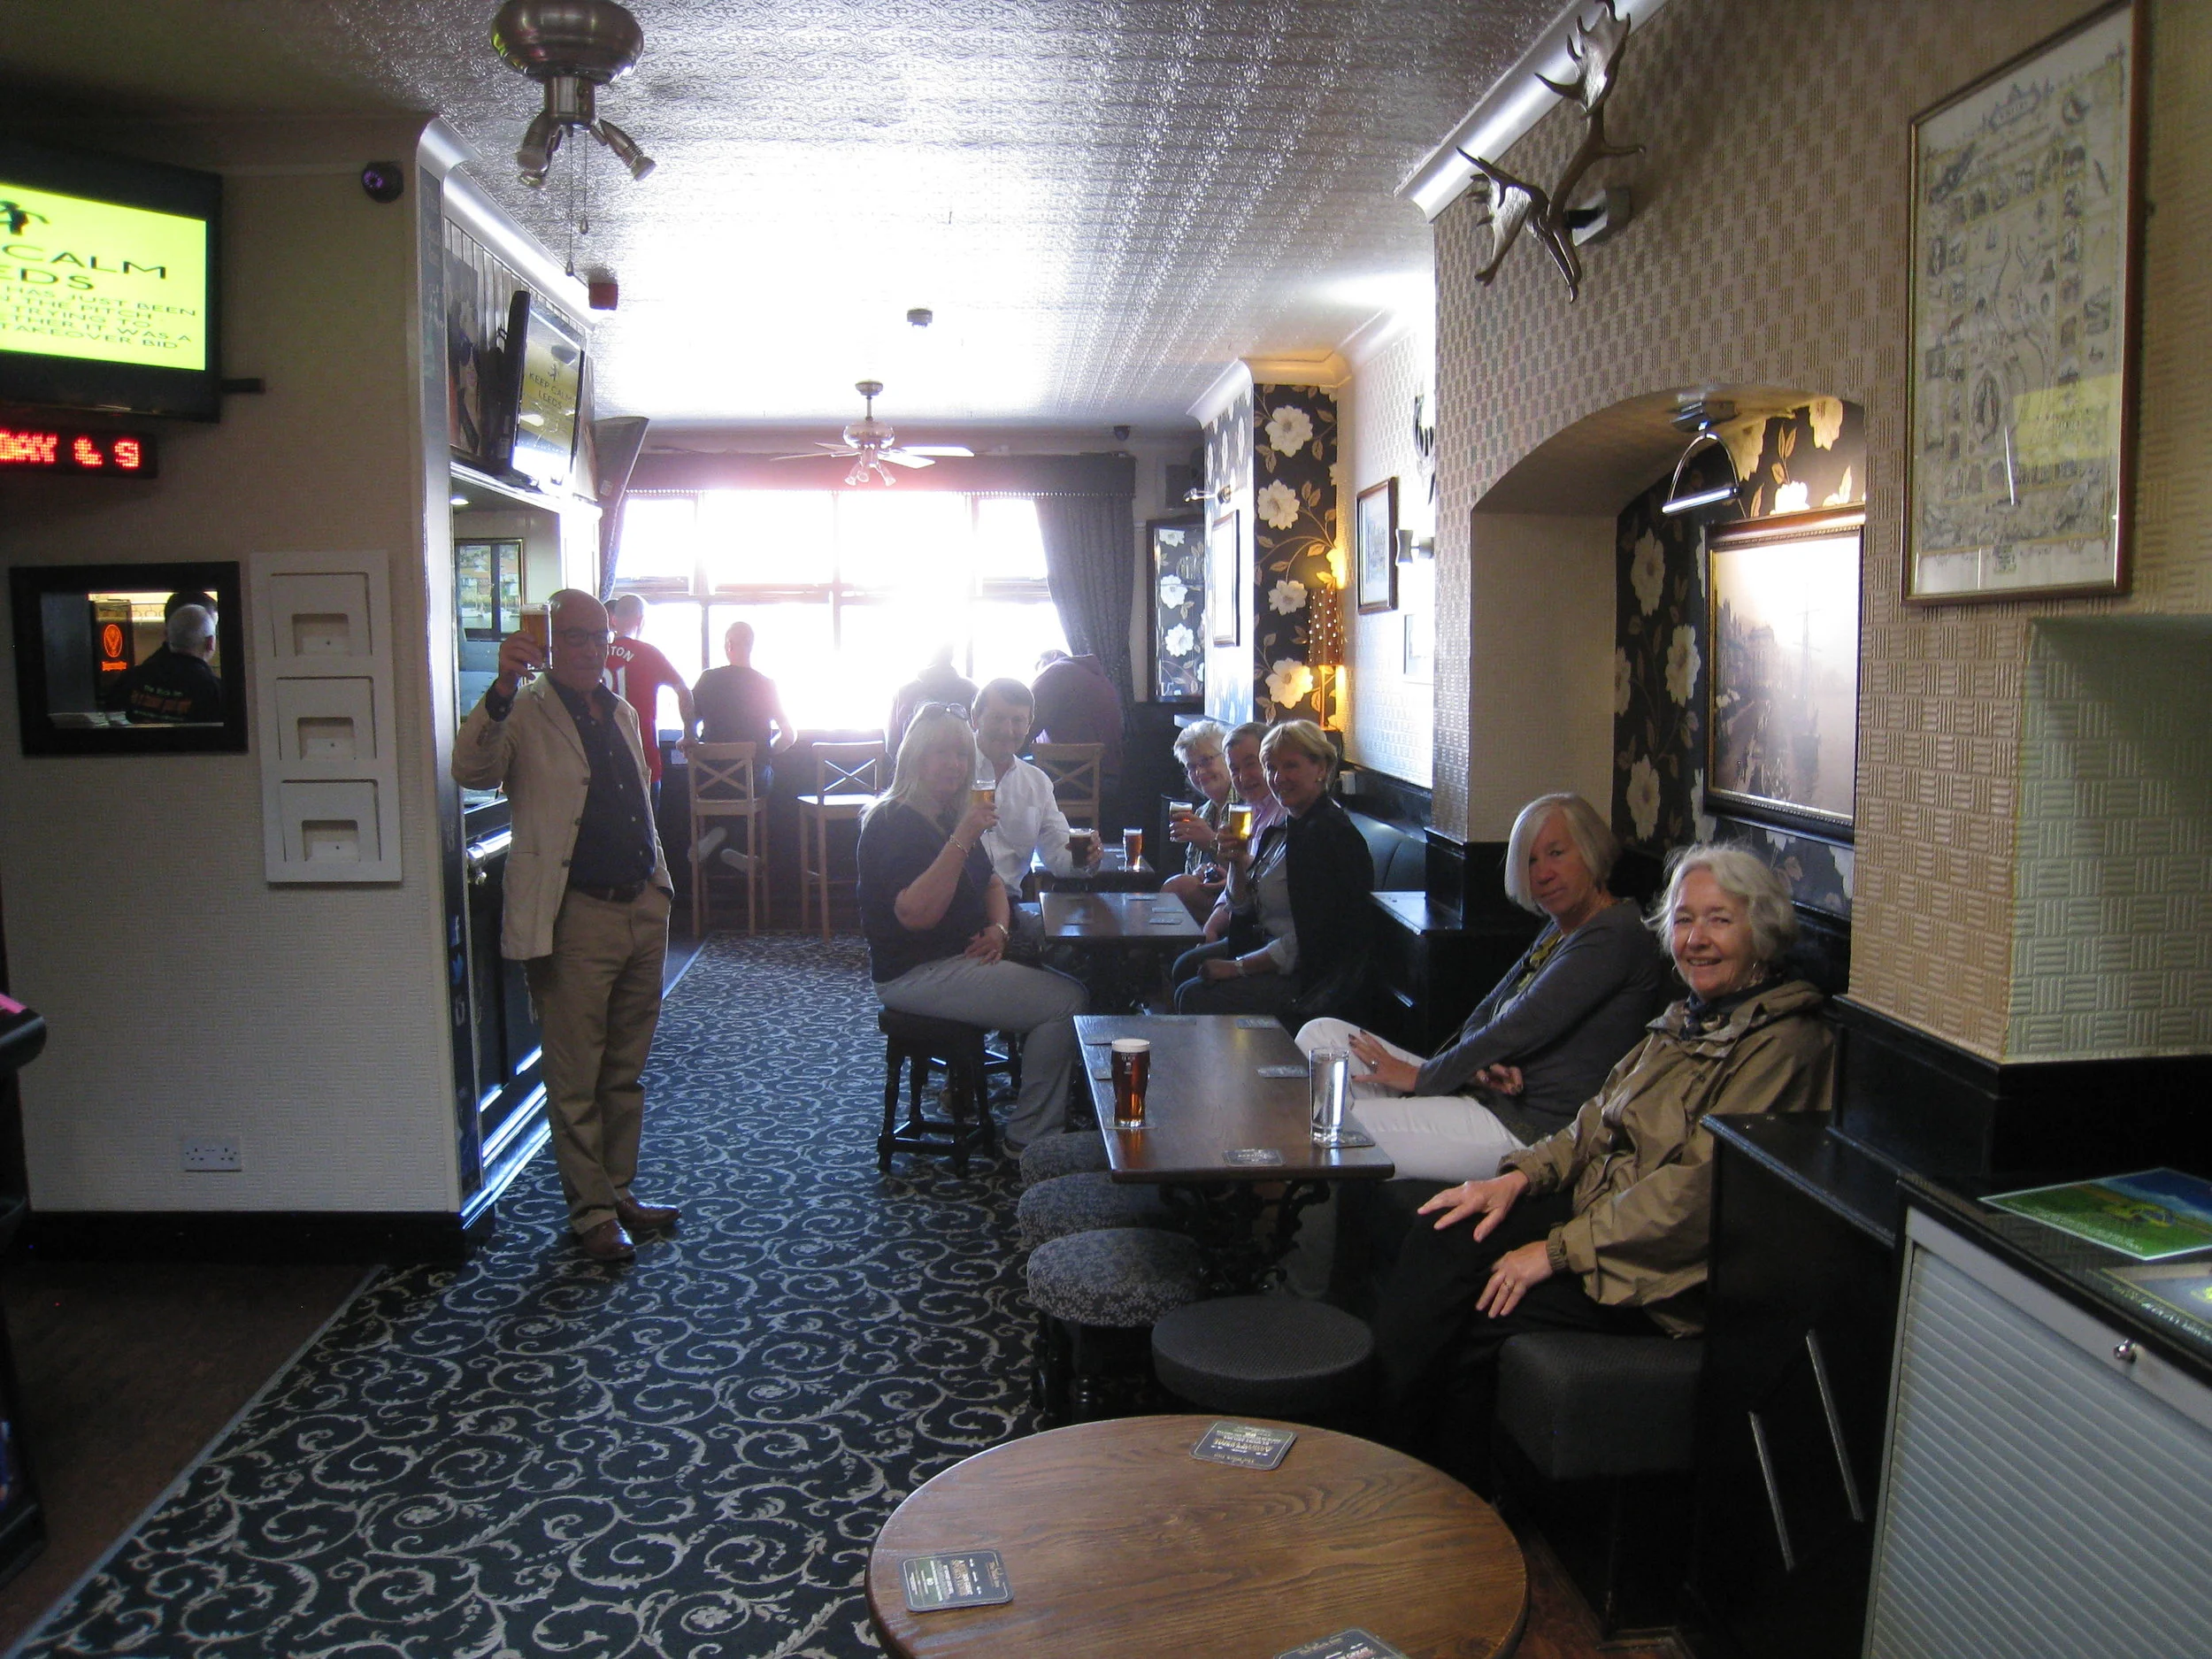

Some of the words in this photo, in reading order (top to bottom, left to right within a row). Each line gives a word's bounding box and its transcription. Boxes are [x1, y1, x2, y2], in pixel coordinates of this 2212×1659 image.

[3, 244, 166, 280] CALM
[6, 286, 55, 297] HAS
[67, 294, 127, 307] JUST
[137, 302, 196, 317] BEEN
[21, 296, 71, 309] THE
[81, 304, 152, 319] PITCH
[0, 313, 76, 328] THER
[117, 326, 169, 340] WAS
[11, 304, 106, 323] TRYING
[118, 318, 151, 328] TO
[142, 339, 178, 349] BID
[529, 372, 550, 389] KEEP
